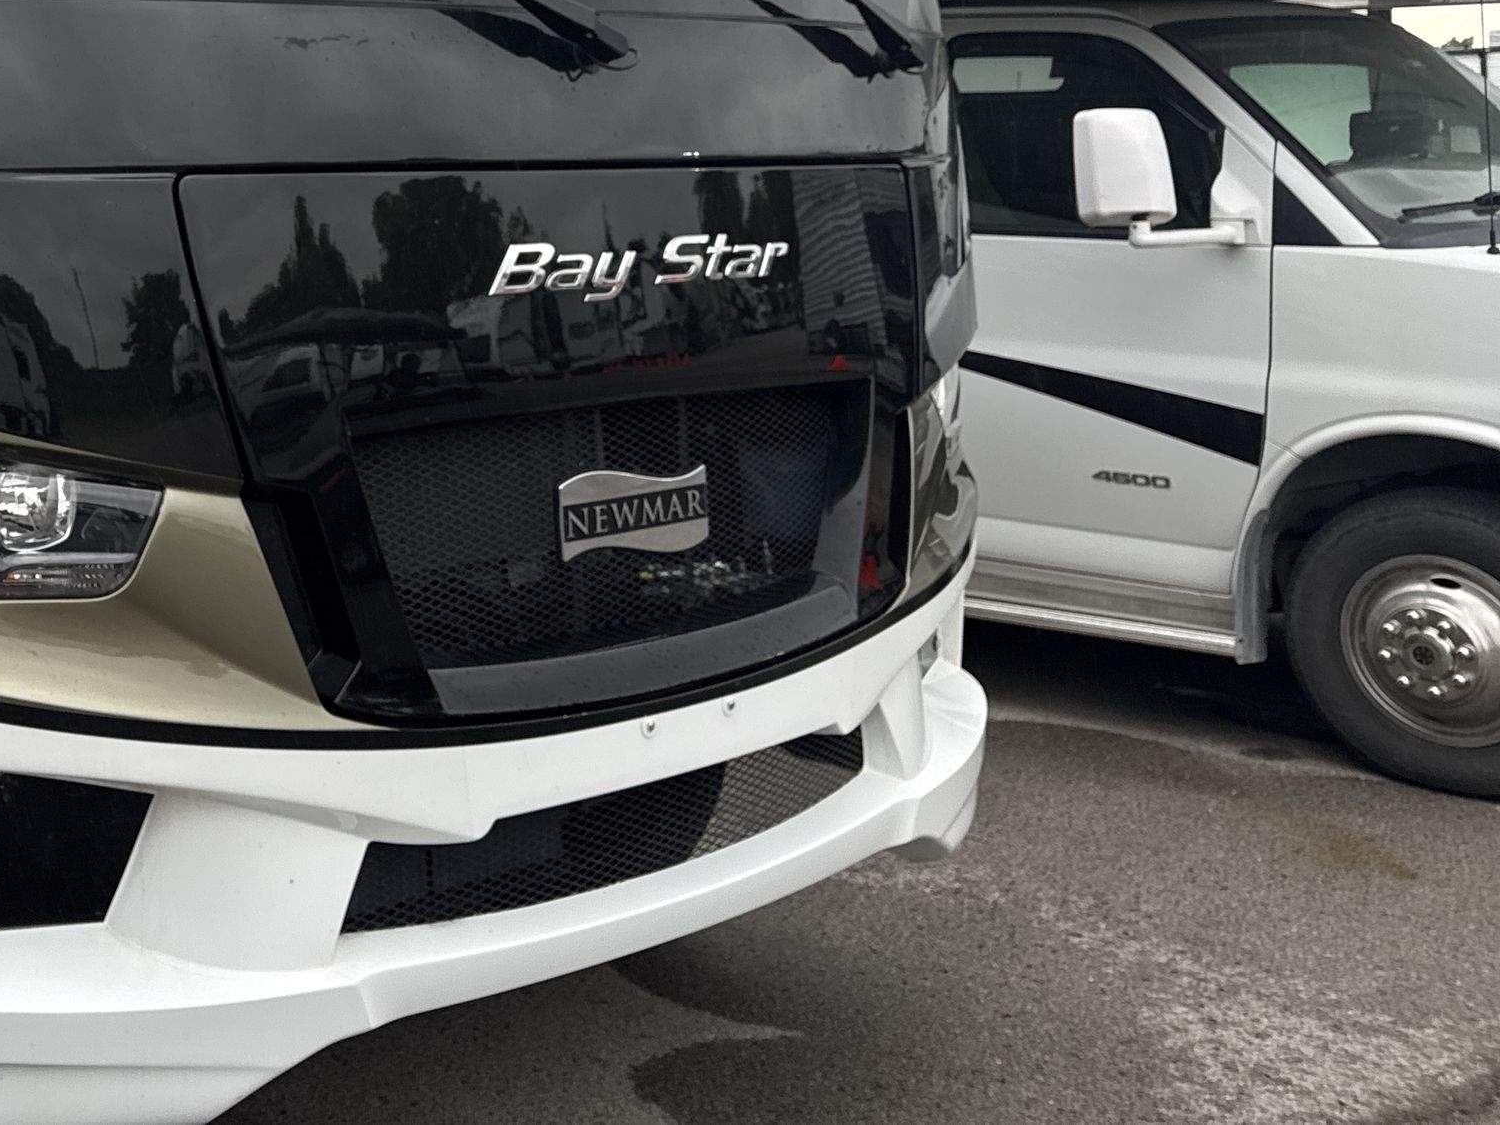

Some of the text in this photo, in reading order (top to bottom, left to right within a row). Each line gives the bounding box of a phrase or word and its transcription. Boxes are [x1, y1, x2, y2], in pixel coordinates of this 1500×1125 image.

[488, 233, 790, 302] Bay Star
[1092, 470, 1171, 489] 4500
[566, 489, 705, 539] NEWMAR
